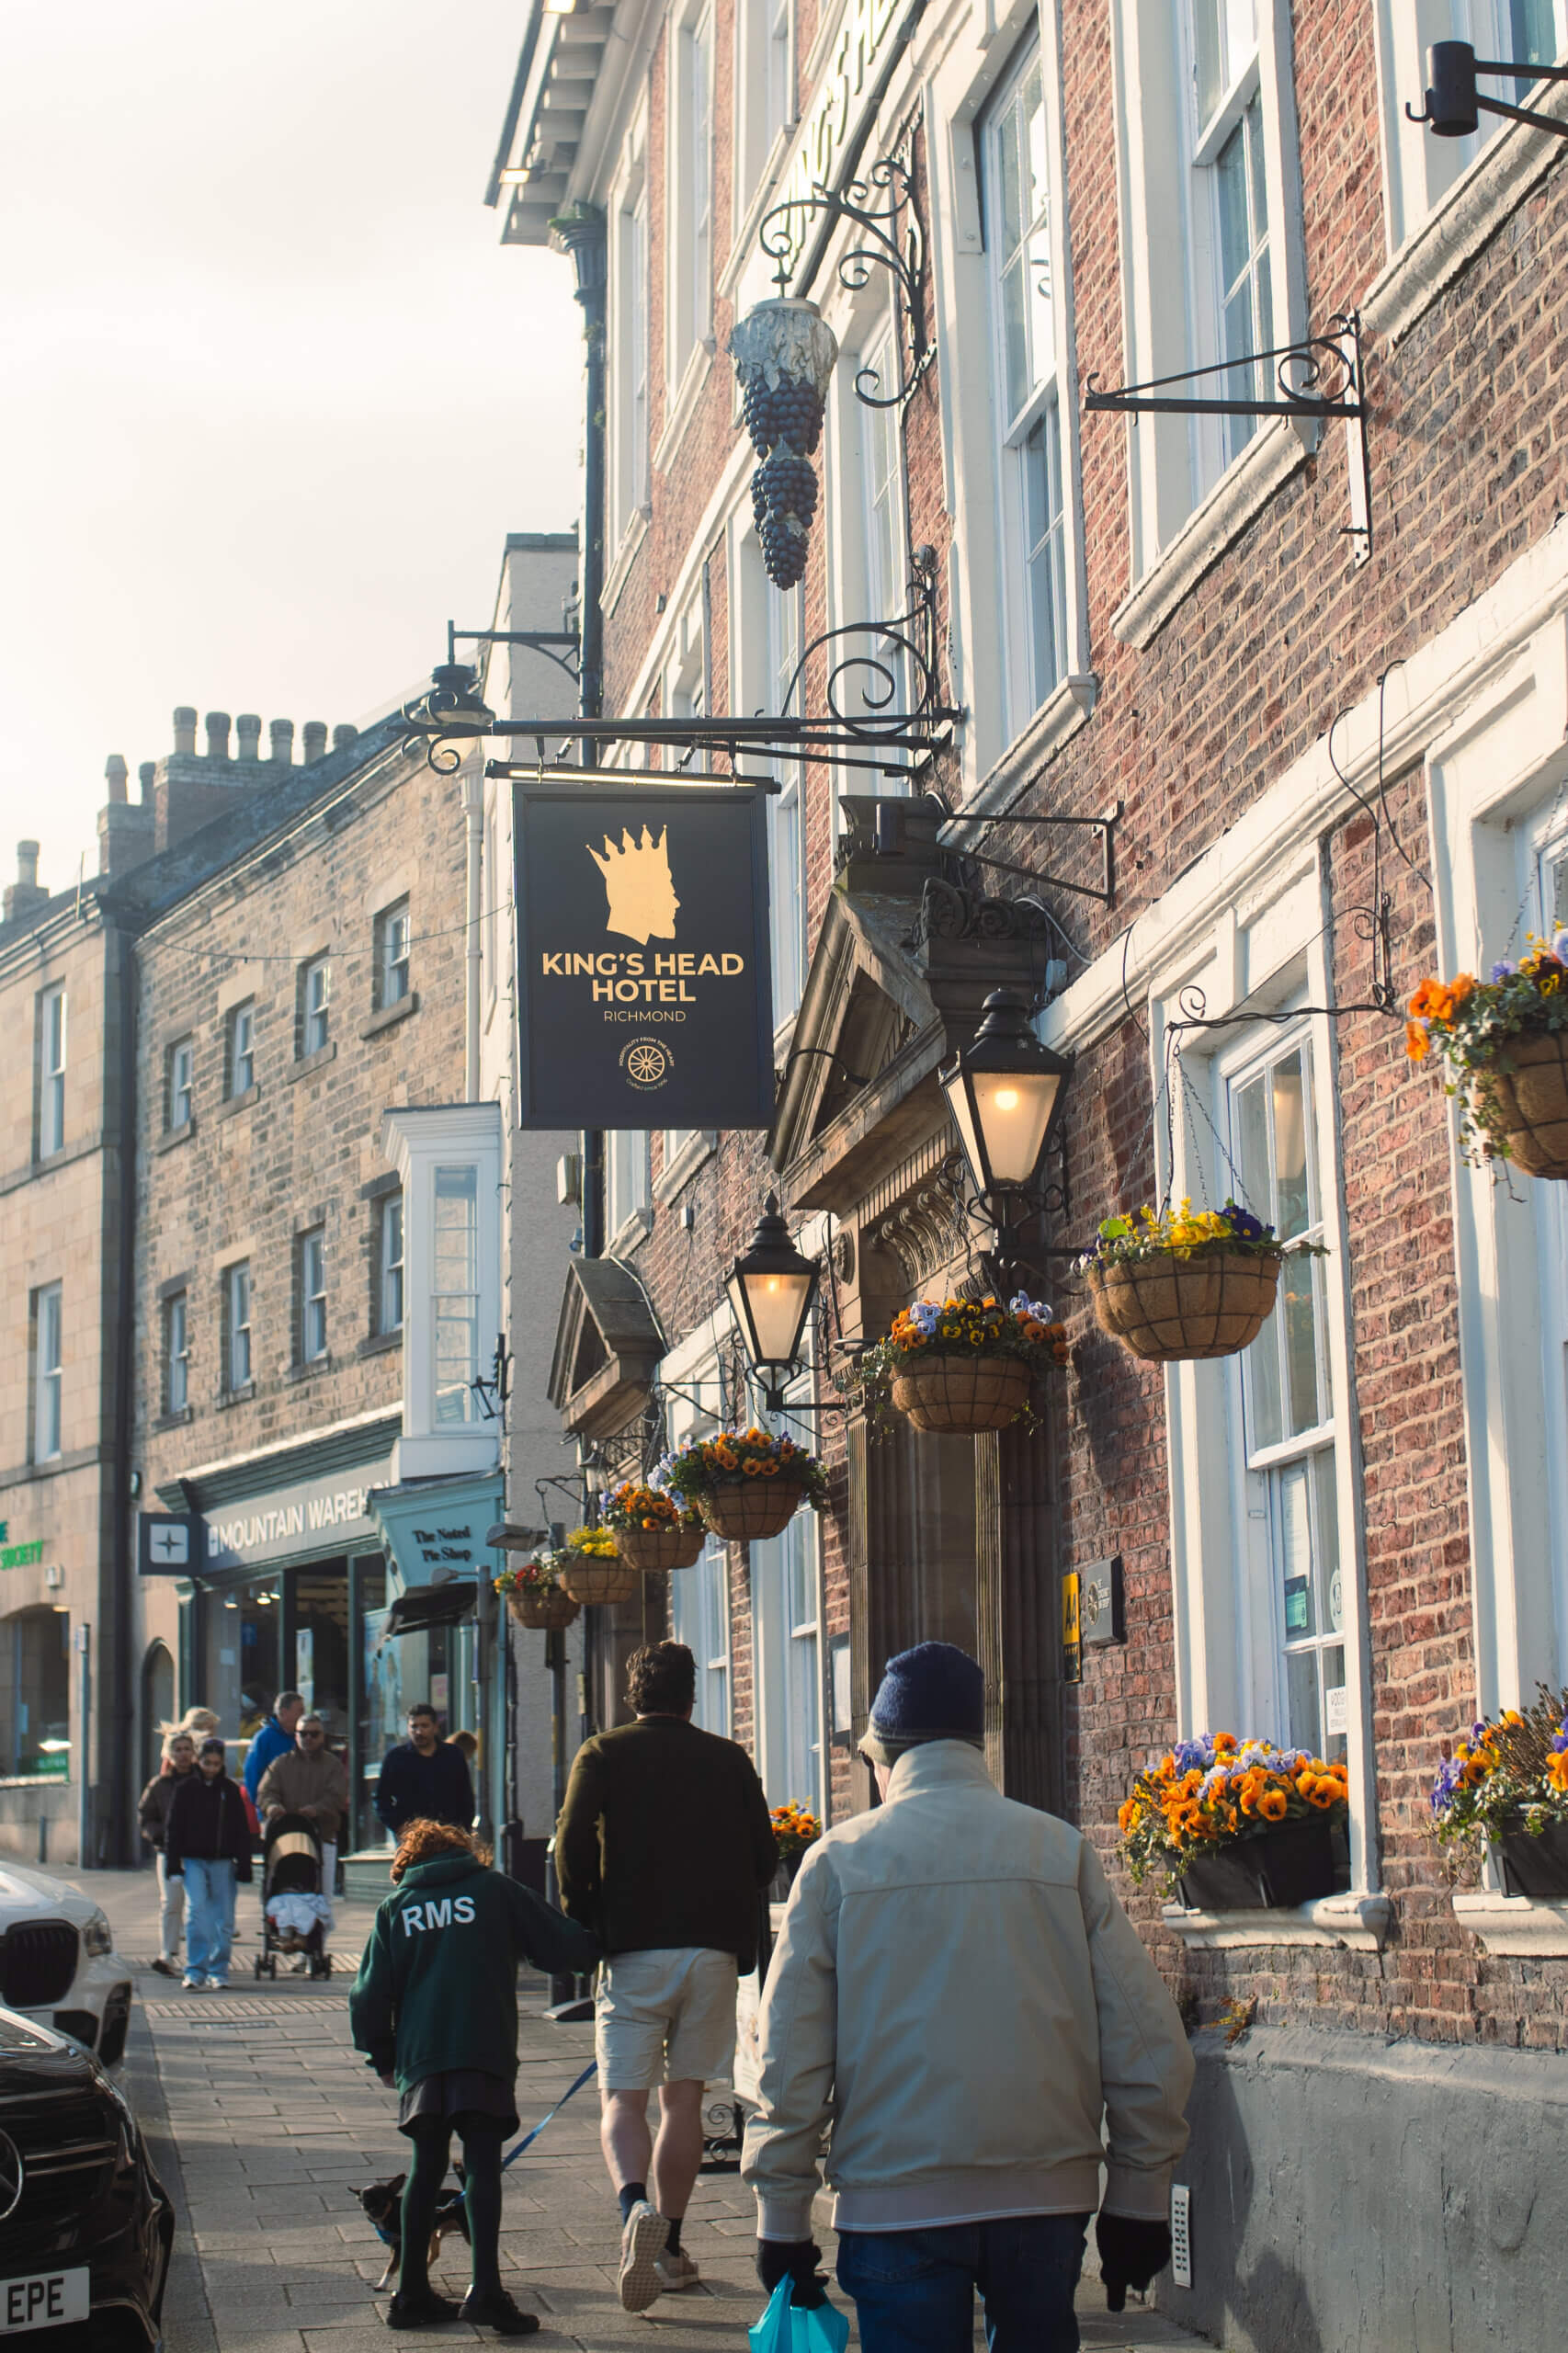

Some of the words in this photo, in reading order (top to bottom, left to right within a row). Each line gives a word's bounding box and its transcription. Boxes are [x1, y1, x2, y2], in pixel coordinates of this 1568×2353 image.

[541, 952, 644, 976] KING'S
[653, 952, 744, 976] HEAD
[592, 979, 697, 1002] HOTEL
[603, 1010, 687, 1023] RICHMOND
[219, 1504, 303, 1553] MOUNTAIN
[412, 1529, 436, 1544] The
[422, 1550, 440, 1562] Pie
[441, 1546, 472, 1562] Shop
[1065, 1592, 1077, 1631] AA
[401, 1895, 476, 1938] RMS
[7, 2277, 64, 2325] EPE
